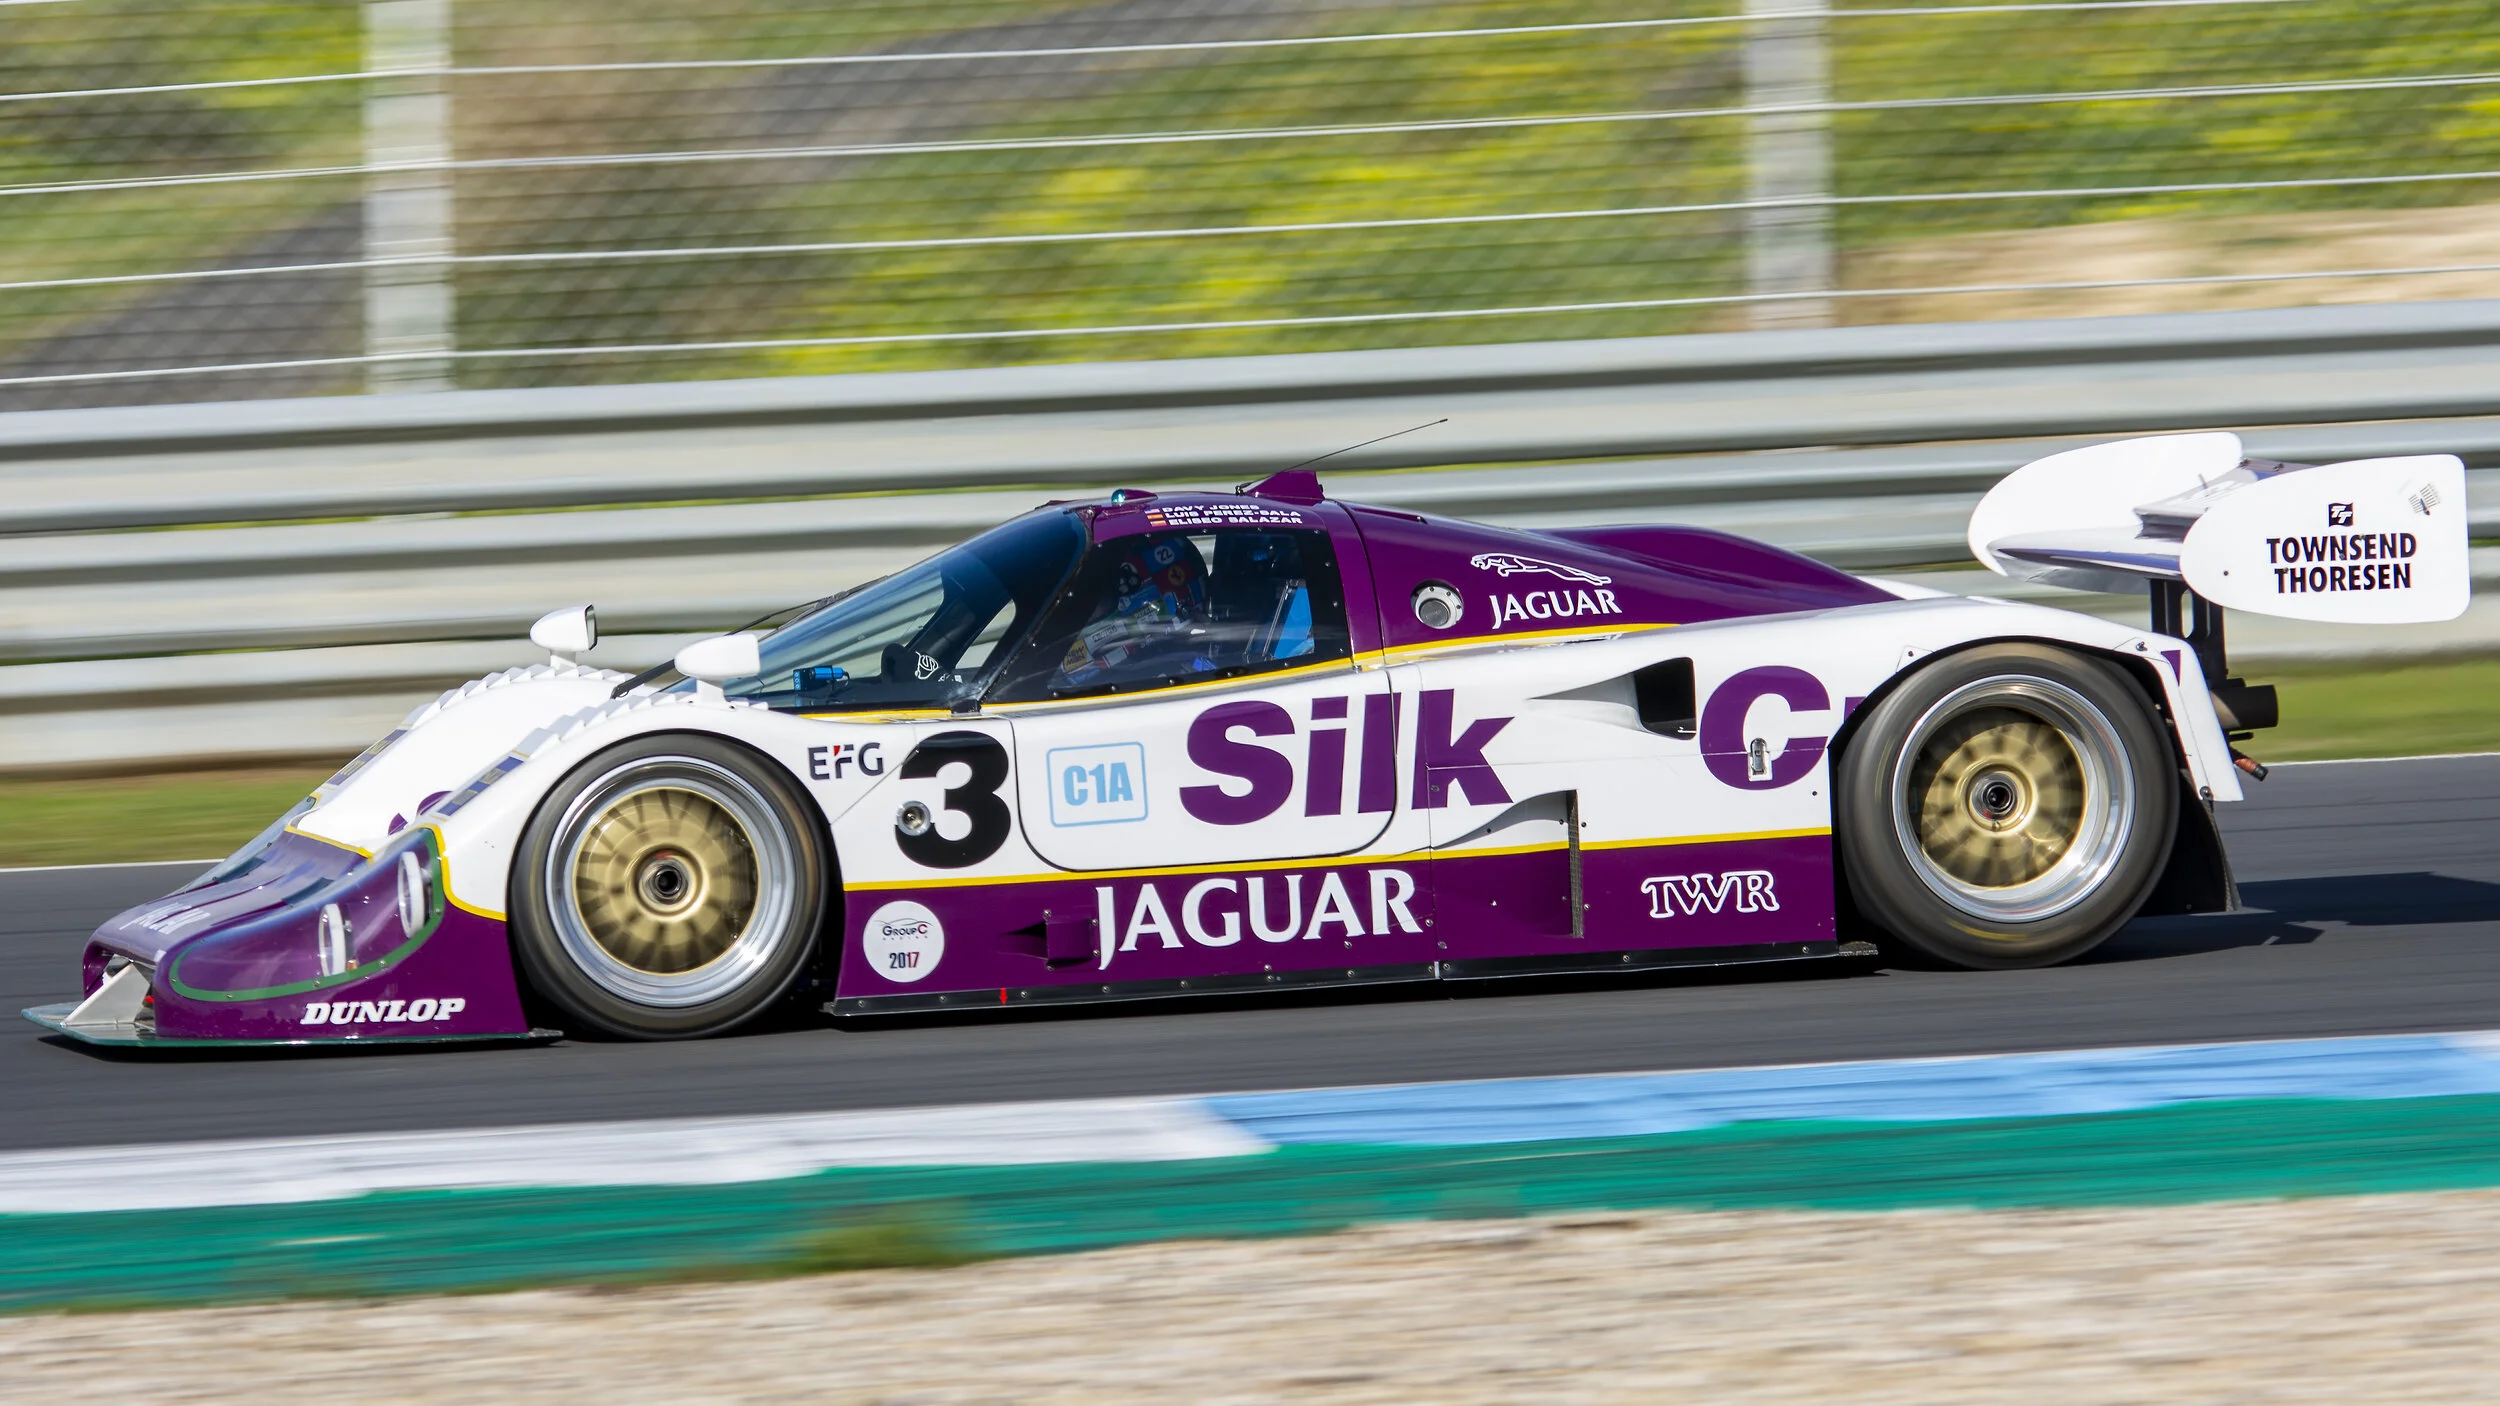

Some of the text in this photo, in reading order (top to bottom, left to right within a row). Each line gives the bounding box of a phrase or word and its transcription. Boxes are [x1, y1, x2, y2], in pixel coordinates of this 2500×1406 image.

[1161, 503, 1260, 513] DAVY JONES
[1164, 507, 1302, 519] LUIS PEREZ-SALA
[1168, 516, 1303, 526] ELISEO SALAZAR
[1157, 547, 1173, 562] 22
[2266, 532, 2417, 565] TOWNSEND
[2274, 562, 2412, 594] THORESEN
[1488, 588, 1622, 629] JAGUAR
[807, 742, 884, 781] EFG
[1179, 688, 1515, 826] Silk
[894, 730, 1011, 869] 3
[1062, 761, 1134, 807] C1A
[1640, 870, 1780, 919] TWR
[1095, 868, 1424, 971] JAGUAR
[889, 951, 920, 969] 2017
[300, 997, 466, 1025] DUNLOP
